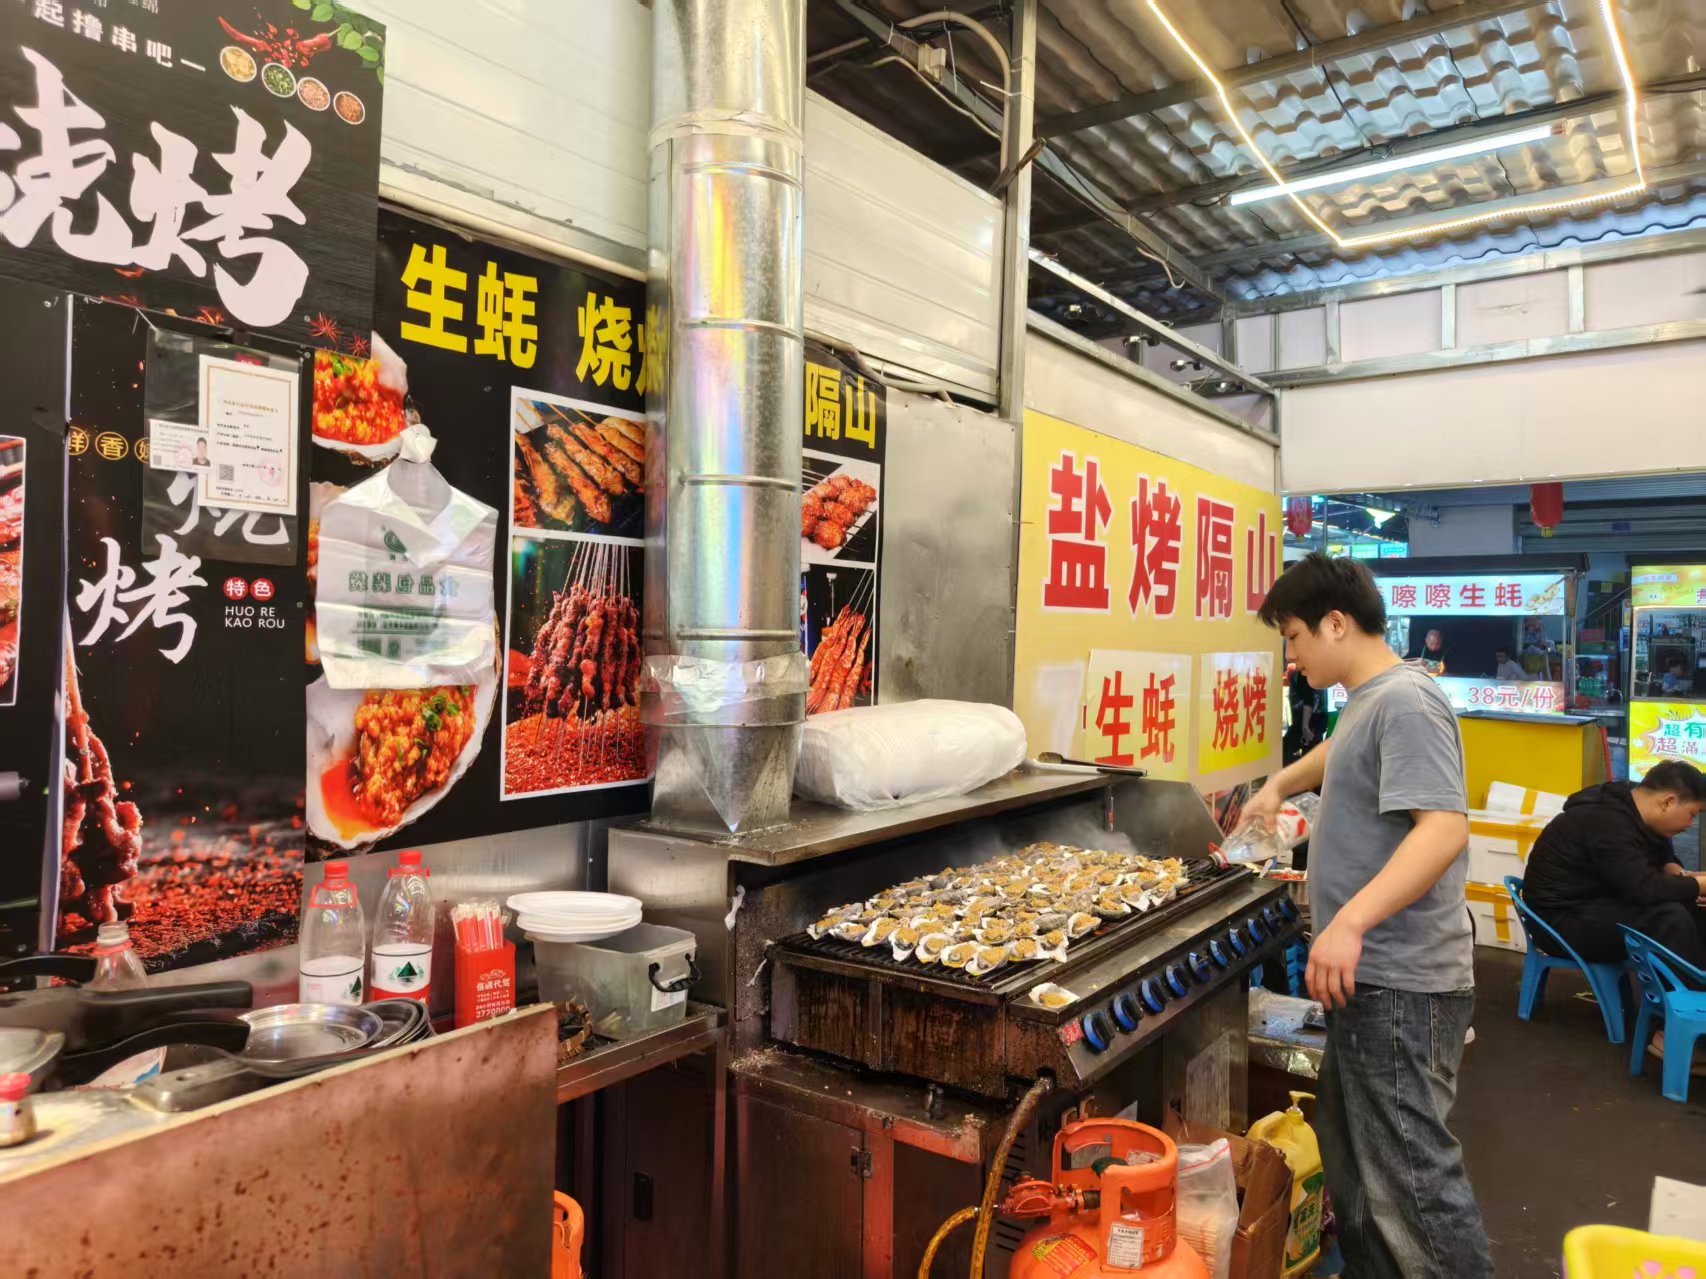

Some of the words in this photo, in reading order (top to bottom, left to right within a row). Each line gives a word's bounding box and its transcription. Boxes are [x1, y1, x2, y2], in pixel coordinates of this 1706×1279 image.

[400, 243, 539, 369] 生蚝
[576, 291, 646, 398] 烧
[804, 361, 876, 450] 隔山
[1043, 453, 1276, 619] 盐烤隔山
[76, 533, 208, 664] 烤
[226, 579, 272, 597] 特色
[1377, 582, 1523, 610] 嚓嚓生蚝
[225, 606, 255, 617] HUO
[260, 606, 276, 617] RE
[225, 617, 253, 628] KAO
[258, 618, 285, 629] ROU
[1468, 686, 1557, 710] 38元/份
[1095, 670, 1176, 767] 生蚝
[1211, 666, 1267, 751] 烧烤
